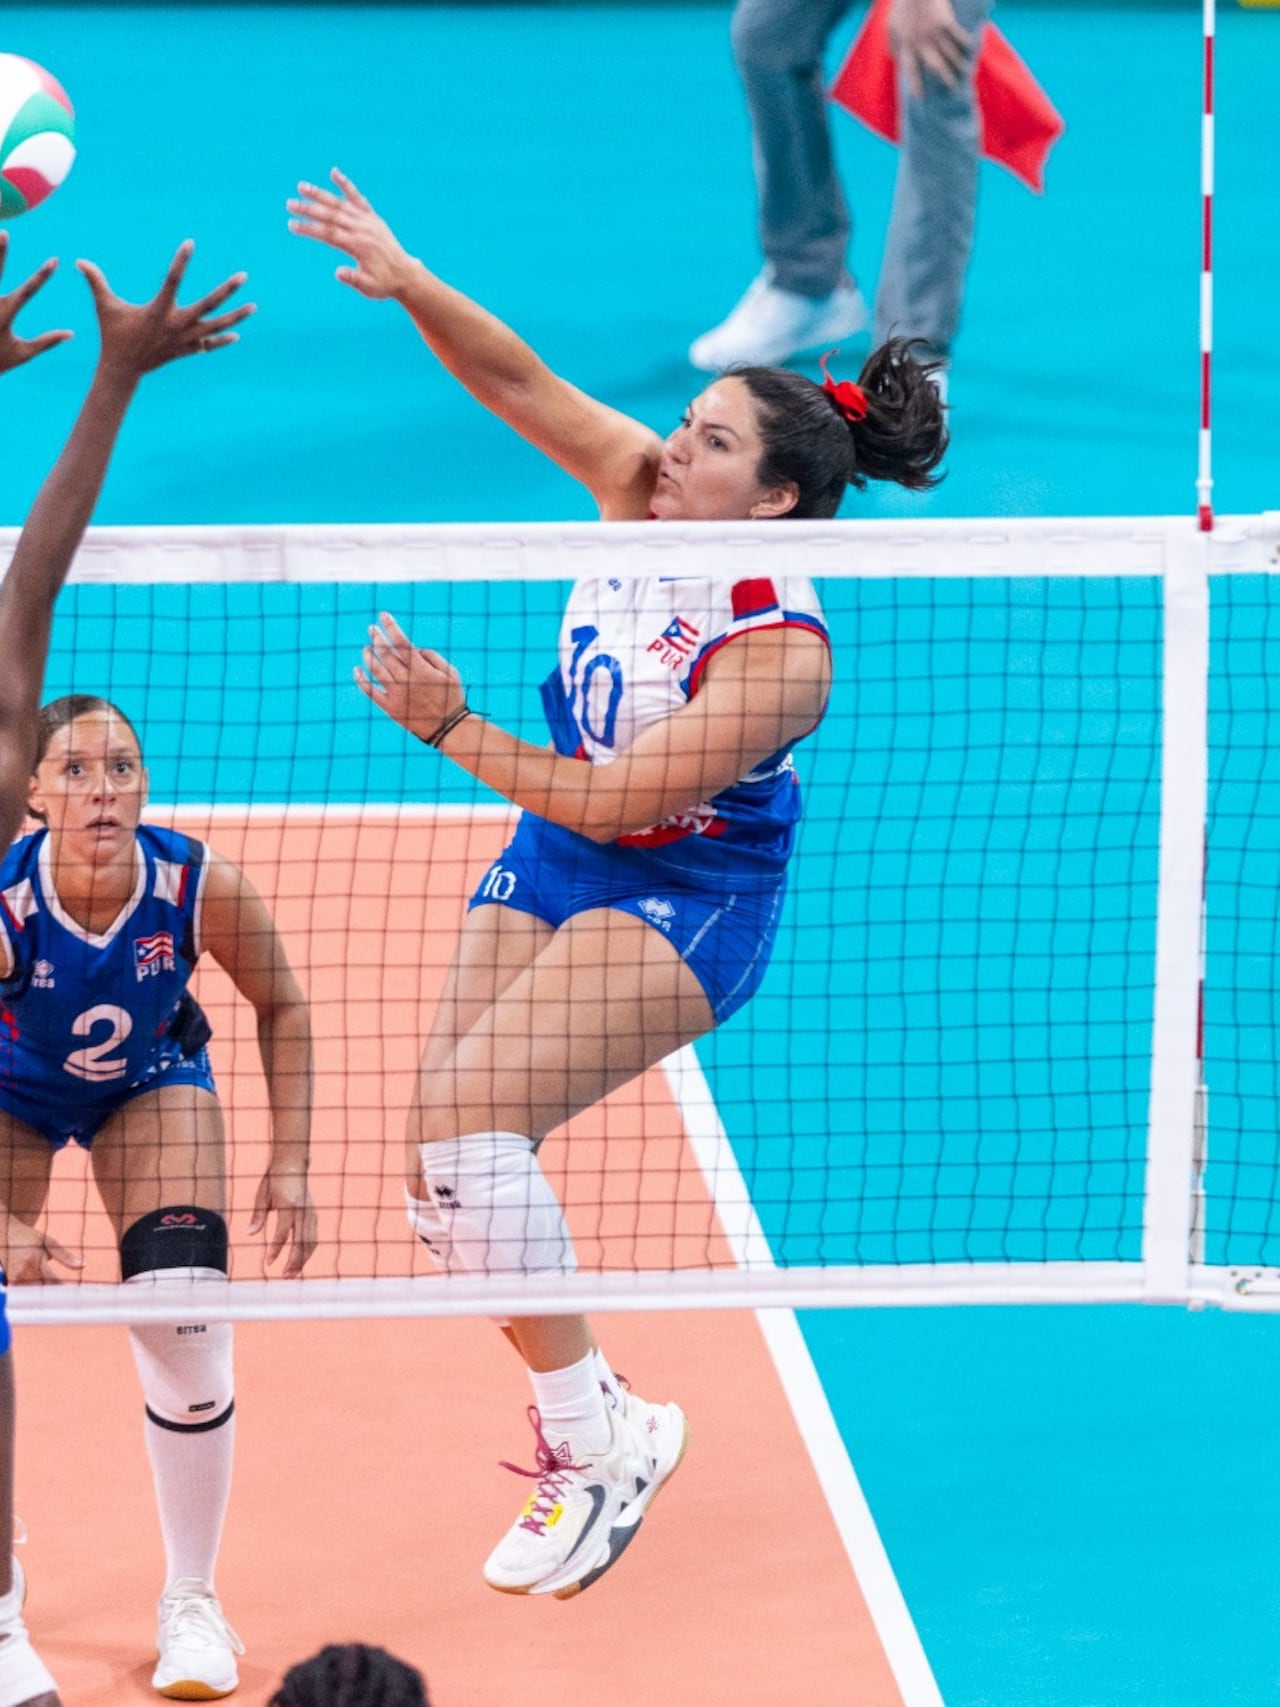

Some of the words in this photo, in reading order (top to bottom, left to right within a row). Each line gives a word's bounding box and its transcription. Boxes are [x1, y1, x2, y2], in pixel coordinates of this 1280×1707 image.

[646, 639, 684, 671] PUR
[571, 625, 624, 749] 10
[483, 865, 517, 900] 10
[136, 954, 176, 982] PUR
[63, 1003, 133, 1082] 2
